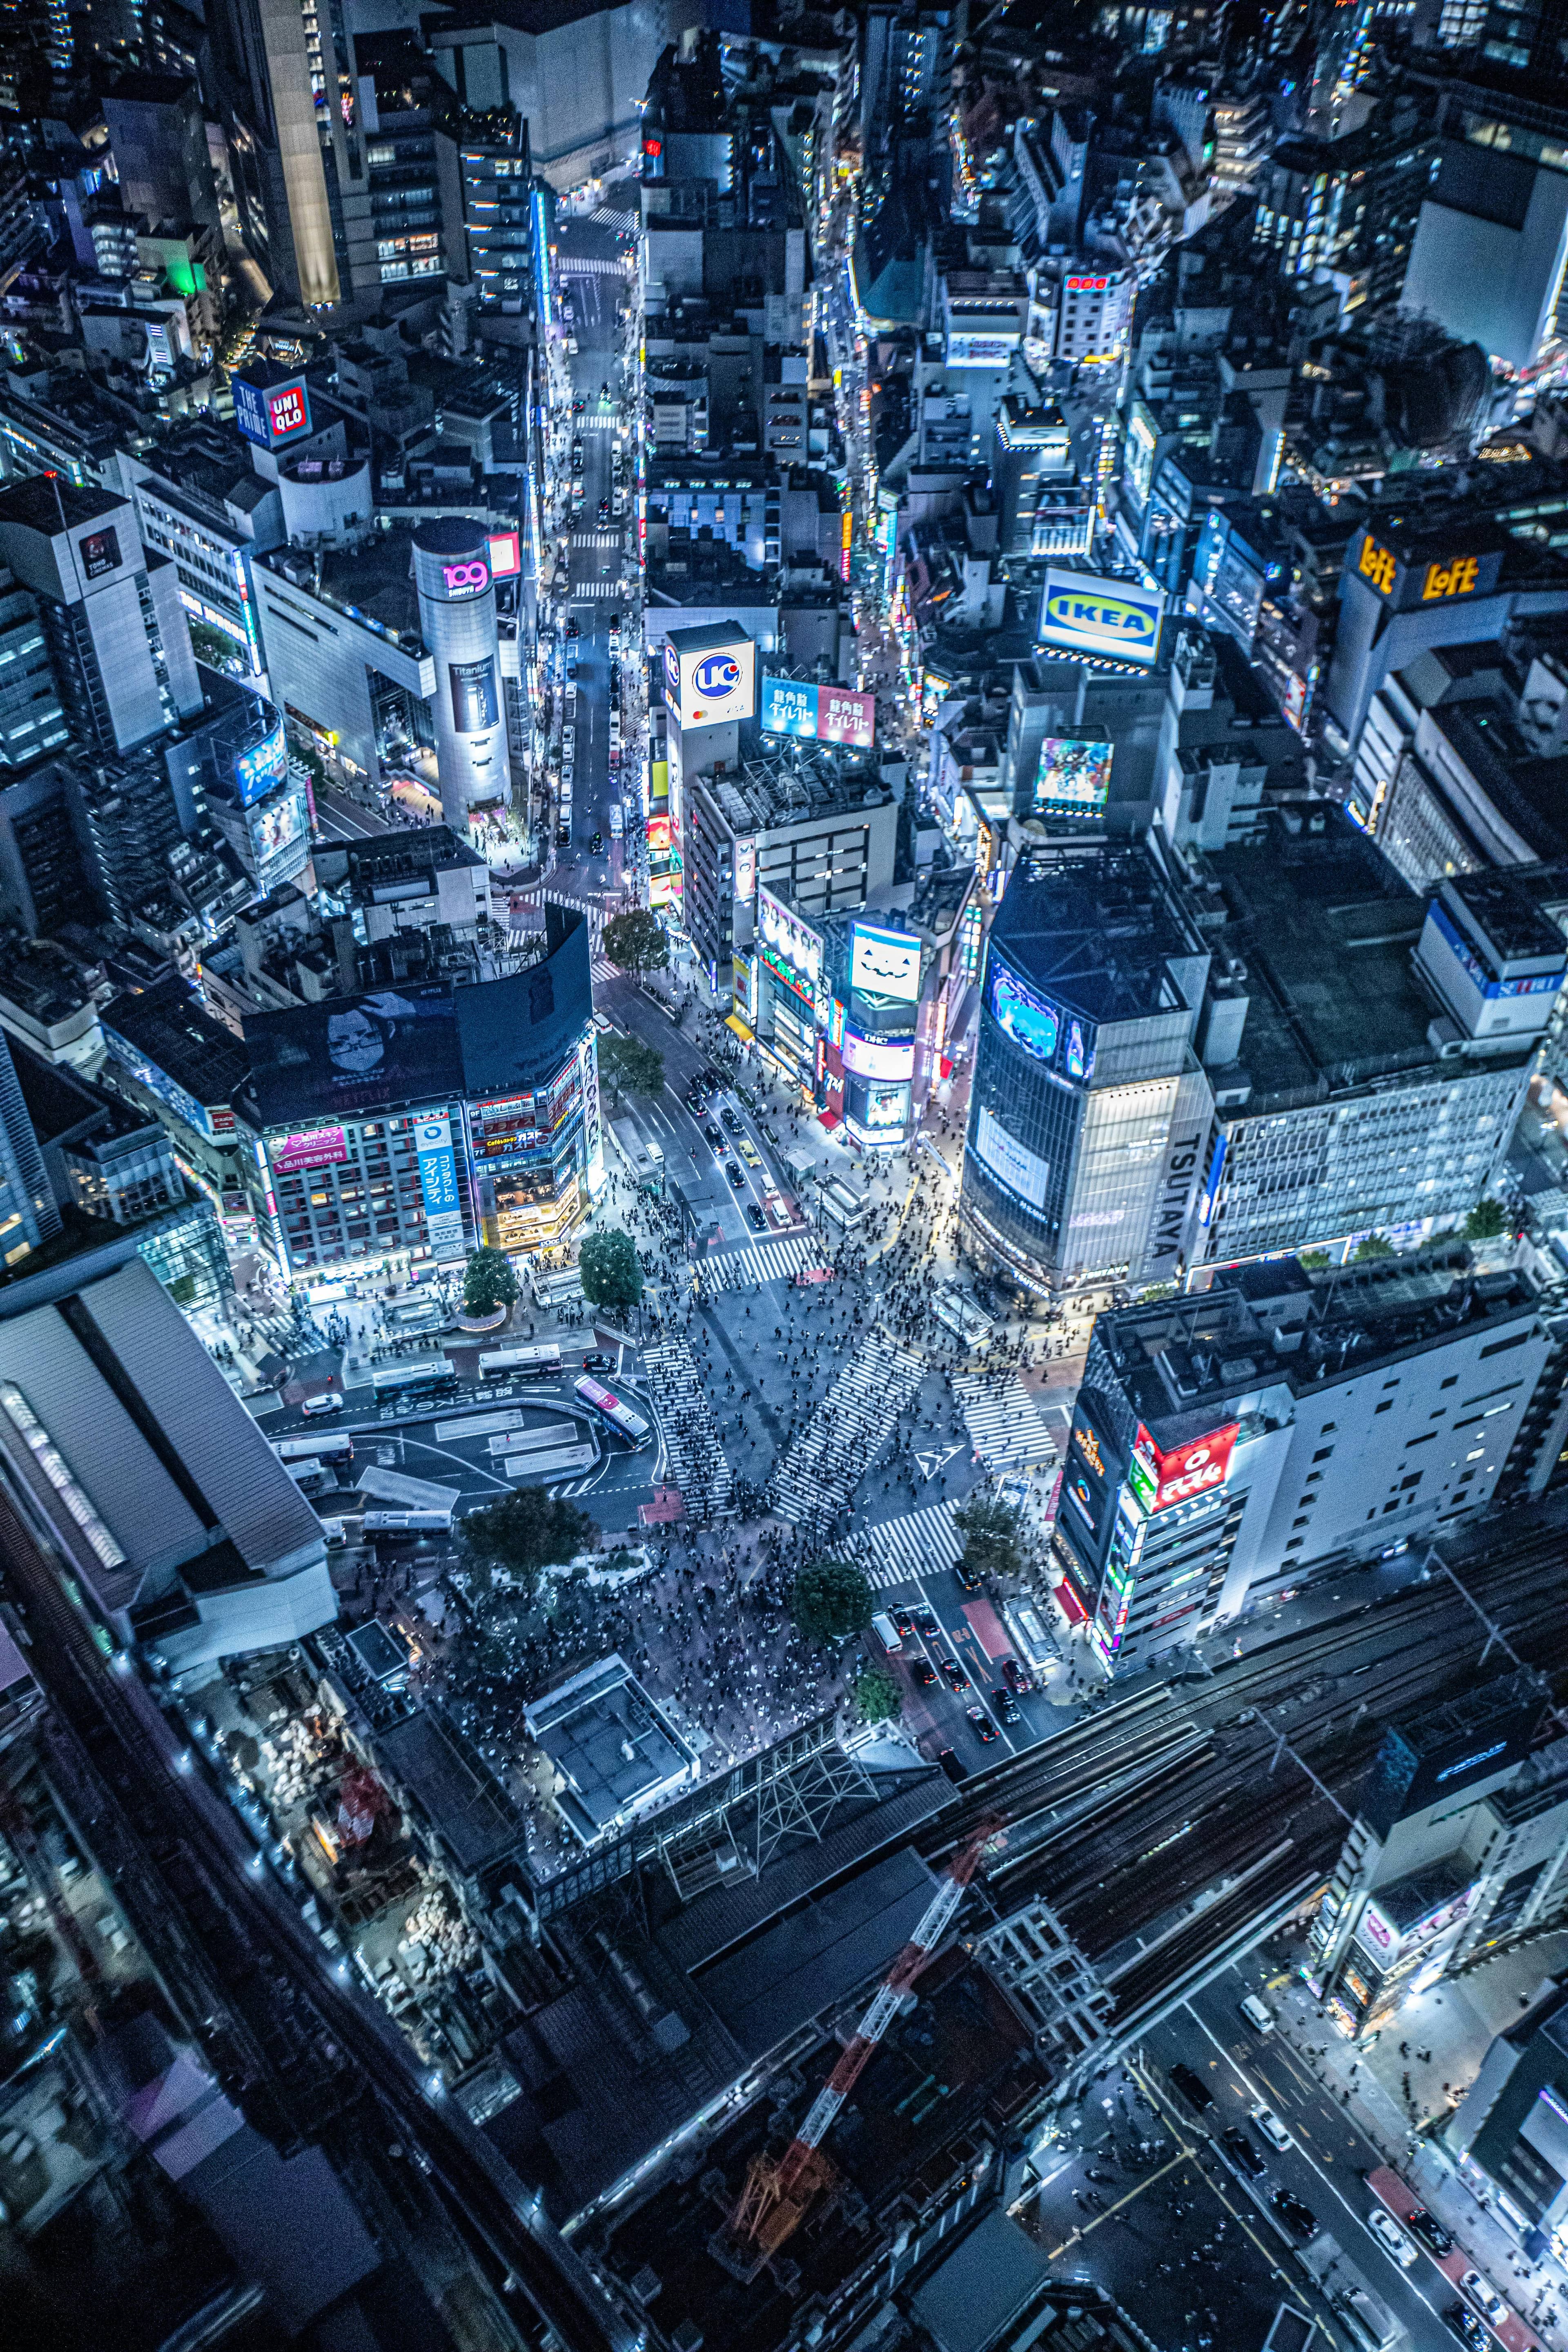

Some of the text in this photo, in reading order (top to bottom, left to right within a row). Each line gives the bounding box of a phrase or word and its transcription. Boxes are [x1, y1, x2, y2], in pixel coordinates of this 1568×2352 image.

[238, 385, 258, 414] THE
[273, 393, 298, 414] UNI
[236, 404, 267, 439] PRIME
[275, 408, 302, 431] QLO
[443, 561, 488, 592] 109
[1058, 600, 1146, 632] IKEA
[864, 1033, 889, 1045] DHC
[301, 1130, 340, 1143] 品川スキン
[303, 1138, 337, 1148] クリニック
[421, 1138, 448, 1147] eyecity
[518, 1131, 543, 1142] ガスト
[283, 1151, 344, 1168] 品川美容外科
[423, 1158, 441, 1205] アイシティ
[439, 1155, 455, 1203] コンタクトの
[1154, 1132, 1200, 1259] TSUTAYA
[1012, 1270, 1050, 1298] TSUTAYA
[1080, 1265, 1129, 1279] TSUTAYA
[1161, 1462, 1222, 1501] アコム
